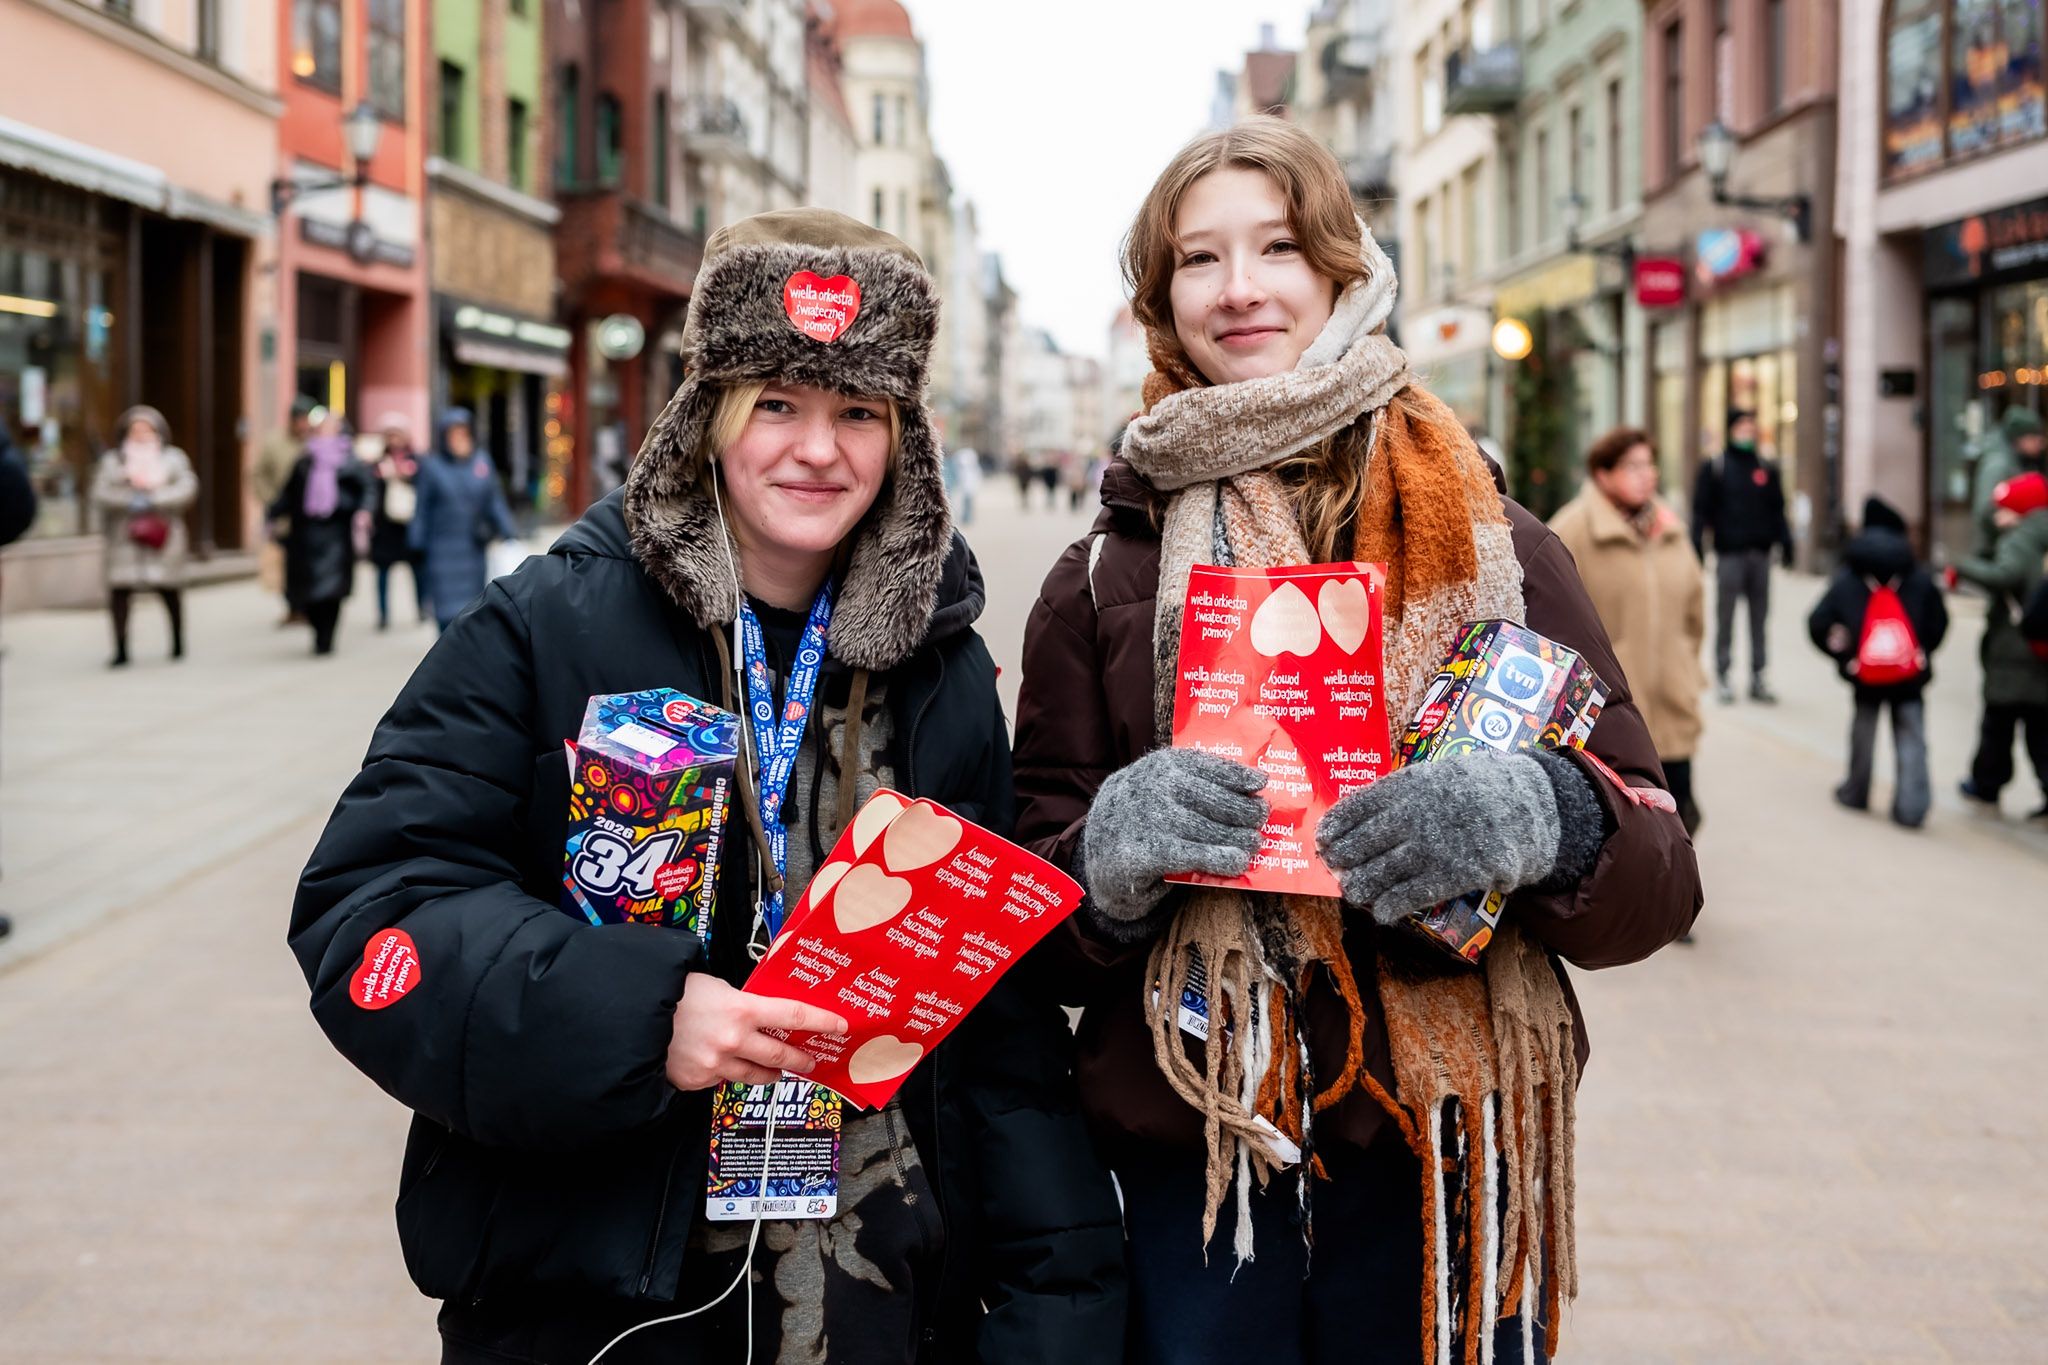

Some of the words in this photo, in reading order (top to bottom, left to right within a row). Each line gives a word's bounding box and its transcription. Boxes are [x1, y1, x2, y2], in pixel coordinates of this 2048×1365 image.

[790, 284, 817, 299] wielka
[818, 288, 854, 306] orkiestra
[795, 301, 847, 326] świątecznej
[804, 320, 837, 338] pomocy
[1190, 591, 1213, 605] wielka
[1213, 595, 1248, 610] orkiestra
[1194, 608, 1241, 631] świątecznej
[744, 620, 755, 655] PIERWSZA
[752, 625, 761, 650] POMOC
[810, 625, 822, 646] 34
[1202, 625, 1234, 643] pomocy
[750, 667, 766, 690] 34
[1184, 665, 1209, 681] wielka
[1210, 669, 1245, 685] orkiestra
[1267, 670, 1300, 686] pomocy
[1323, 669, 1348, 685] wielka
[1348, 670, 1375, 686] orkiestra
[1505, 663, 1537, 690] tvn
[1189, 680, 1239, 706] świątecznej
[1330, 687, 1373, 708] świątecznej
[1198, 702, 1231, 718] pomocy
[1253, 705, 1288, 719] orkiestra
[1289, 706, 1315, 722] wielka
[1339, 704, 1368, 721] pomocy
[1487, 718, 1505, 732] PZU
[780, 726, 800, 750] 112
[1264, 743, 1297, 762] pomocy
[1322, 746, 1349, 762] wielka
[1349, 748, 1382, 764] orkiestra
[767, 755, 783, 786] PIERWSZA
[776, 757, 789, 782] POMOC
[1285, 781, 1313, 798] wielka
[710, 777, 727, 837] CHOROBY
[764, 799, 775, 822] 34
[594, 816, 635, 839] 2026
[578, 836, 677, 894] 34
[701, 835, 719, 898] PRZEWODU
[966, 846, 998, 868] pomocy
[1281, 858, 1310, 874] wielka
[934, 867, 965, 889] orkiestra
[964, 881, 988, 899] wielka
[1010, 872, 1035, 887] wielka
[1032, 881, 1063, 907] orkiestra
[616, 896, 665, 915] FINAŁ
[1000, 901, 1031, 923] pomocy
[916, 906, 949, 928] pomocy
[885, 927, 915, 949] orkiestra
[962, 931, 985, 947] wielka
[983, 940, 1012, 960] orkiestra
[797, 936, 822, 954] wielka
[820, 945, 852, 968] orkiestra
[914, 940, 939, 959] wielka
[361, 972, 379, 1003] wielka
[372, 935, 398, 972] orkiestra
[375, 944, 412, 1000] świątecznej
[393, 956, 417, 993] pomocy
[788, 966, 822, 989] pomocy
[868, 966, 900, 989] pomocy
[953, 960, 982, 981] pomocy
[837, 987, 868, 1009] orkiestra
[914, 990, 937, 1006] wielka
[935, 1000, 964, 1016] orkiestra
[866, 1003, 891, 1019] wielka
[904, 1018, 933, 1036] pomocy
[746, 1085, 765, 1102] A
